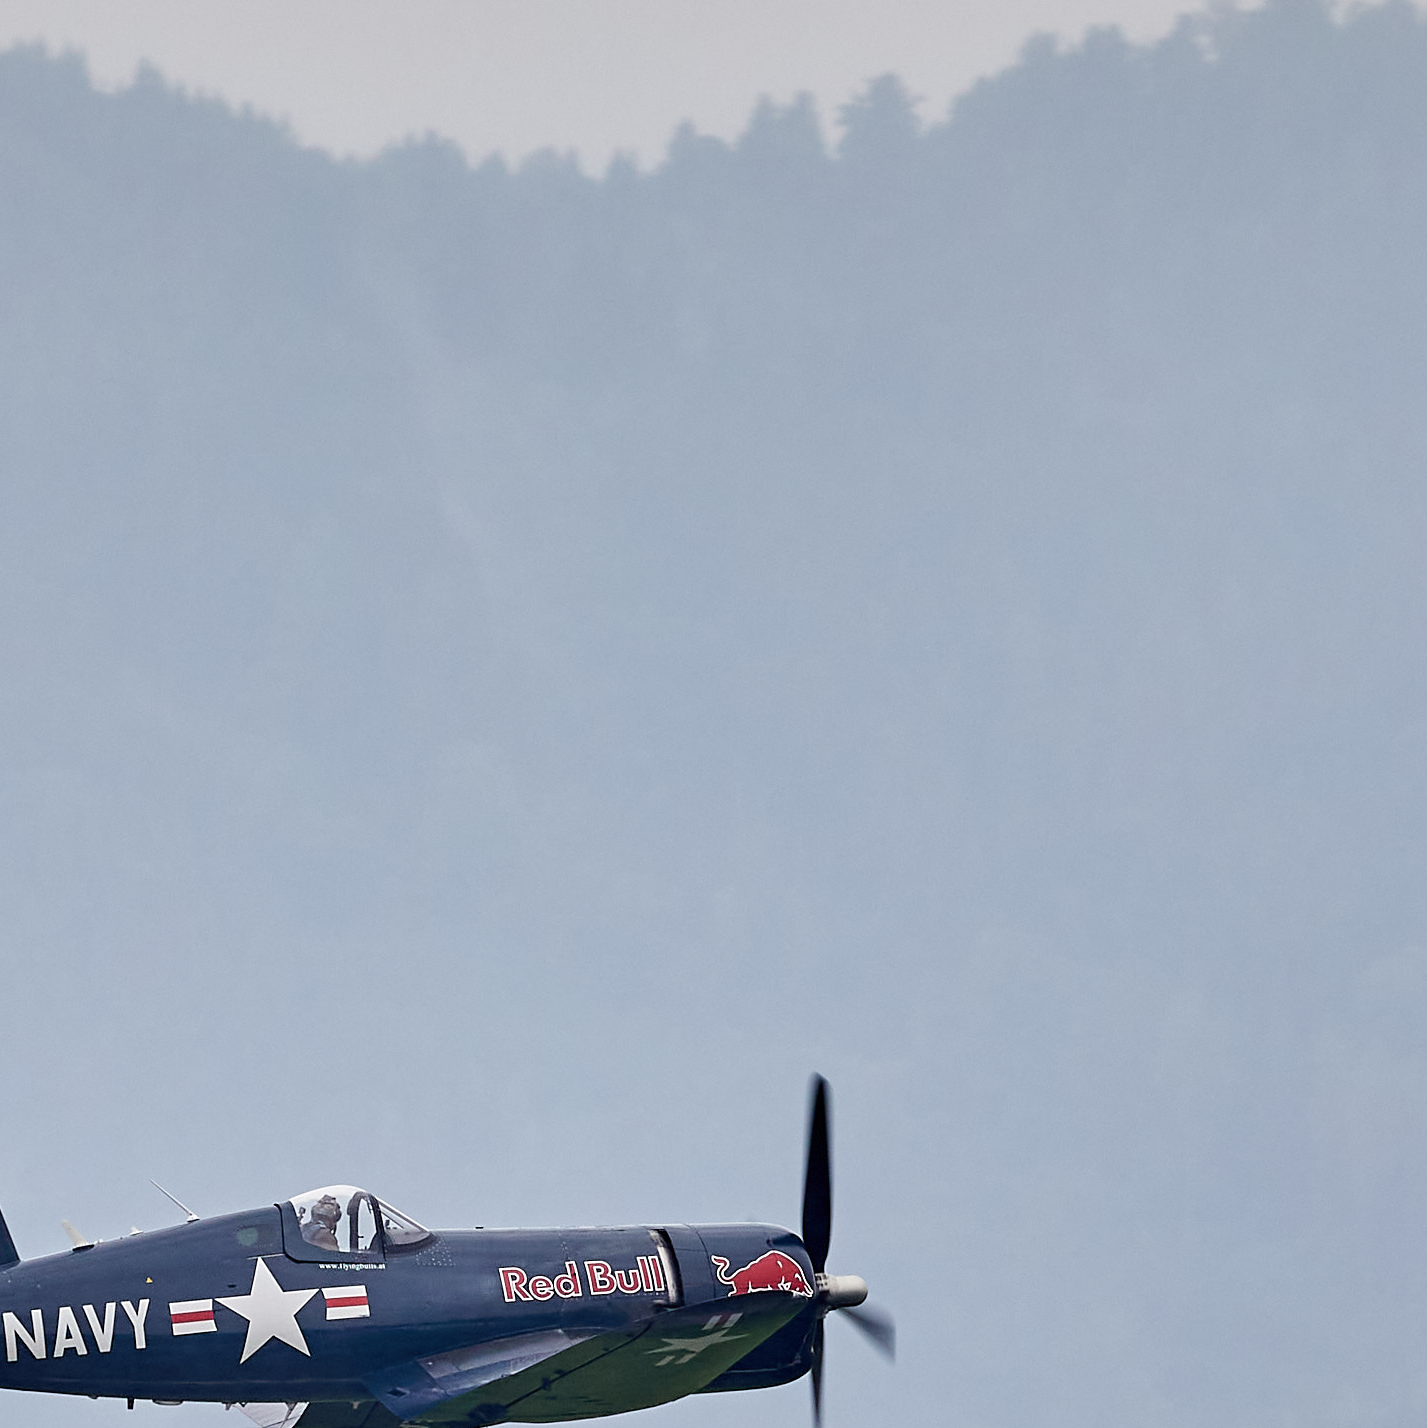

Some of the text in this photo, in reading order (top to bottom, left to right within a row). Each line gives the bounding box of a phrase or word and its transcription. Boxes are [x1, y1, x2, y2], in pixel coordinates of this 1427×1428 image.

[498, 1255, 666, 1302] Red Bull
[1, 1297, 151, 1362] NAVY
